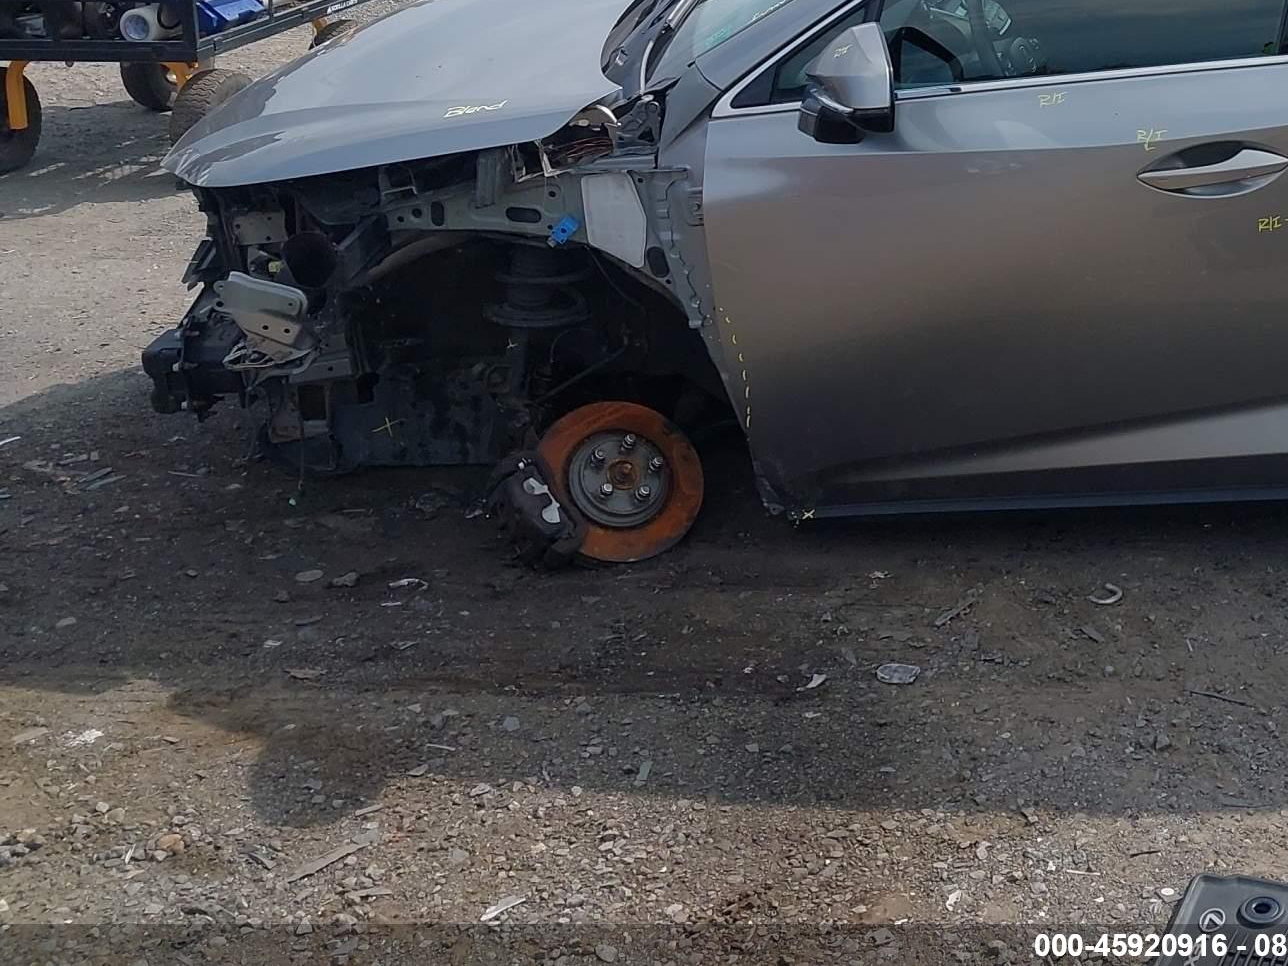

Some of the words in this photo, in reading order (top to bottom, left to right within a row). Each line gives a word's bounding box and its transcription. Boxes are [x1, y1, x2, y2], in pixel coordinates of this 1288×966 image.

[1037, 91, 1068, 108] R/I
[443, 99, 508, 118] Blend
[1257, 215, 1282, 232] R/I
